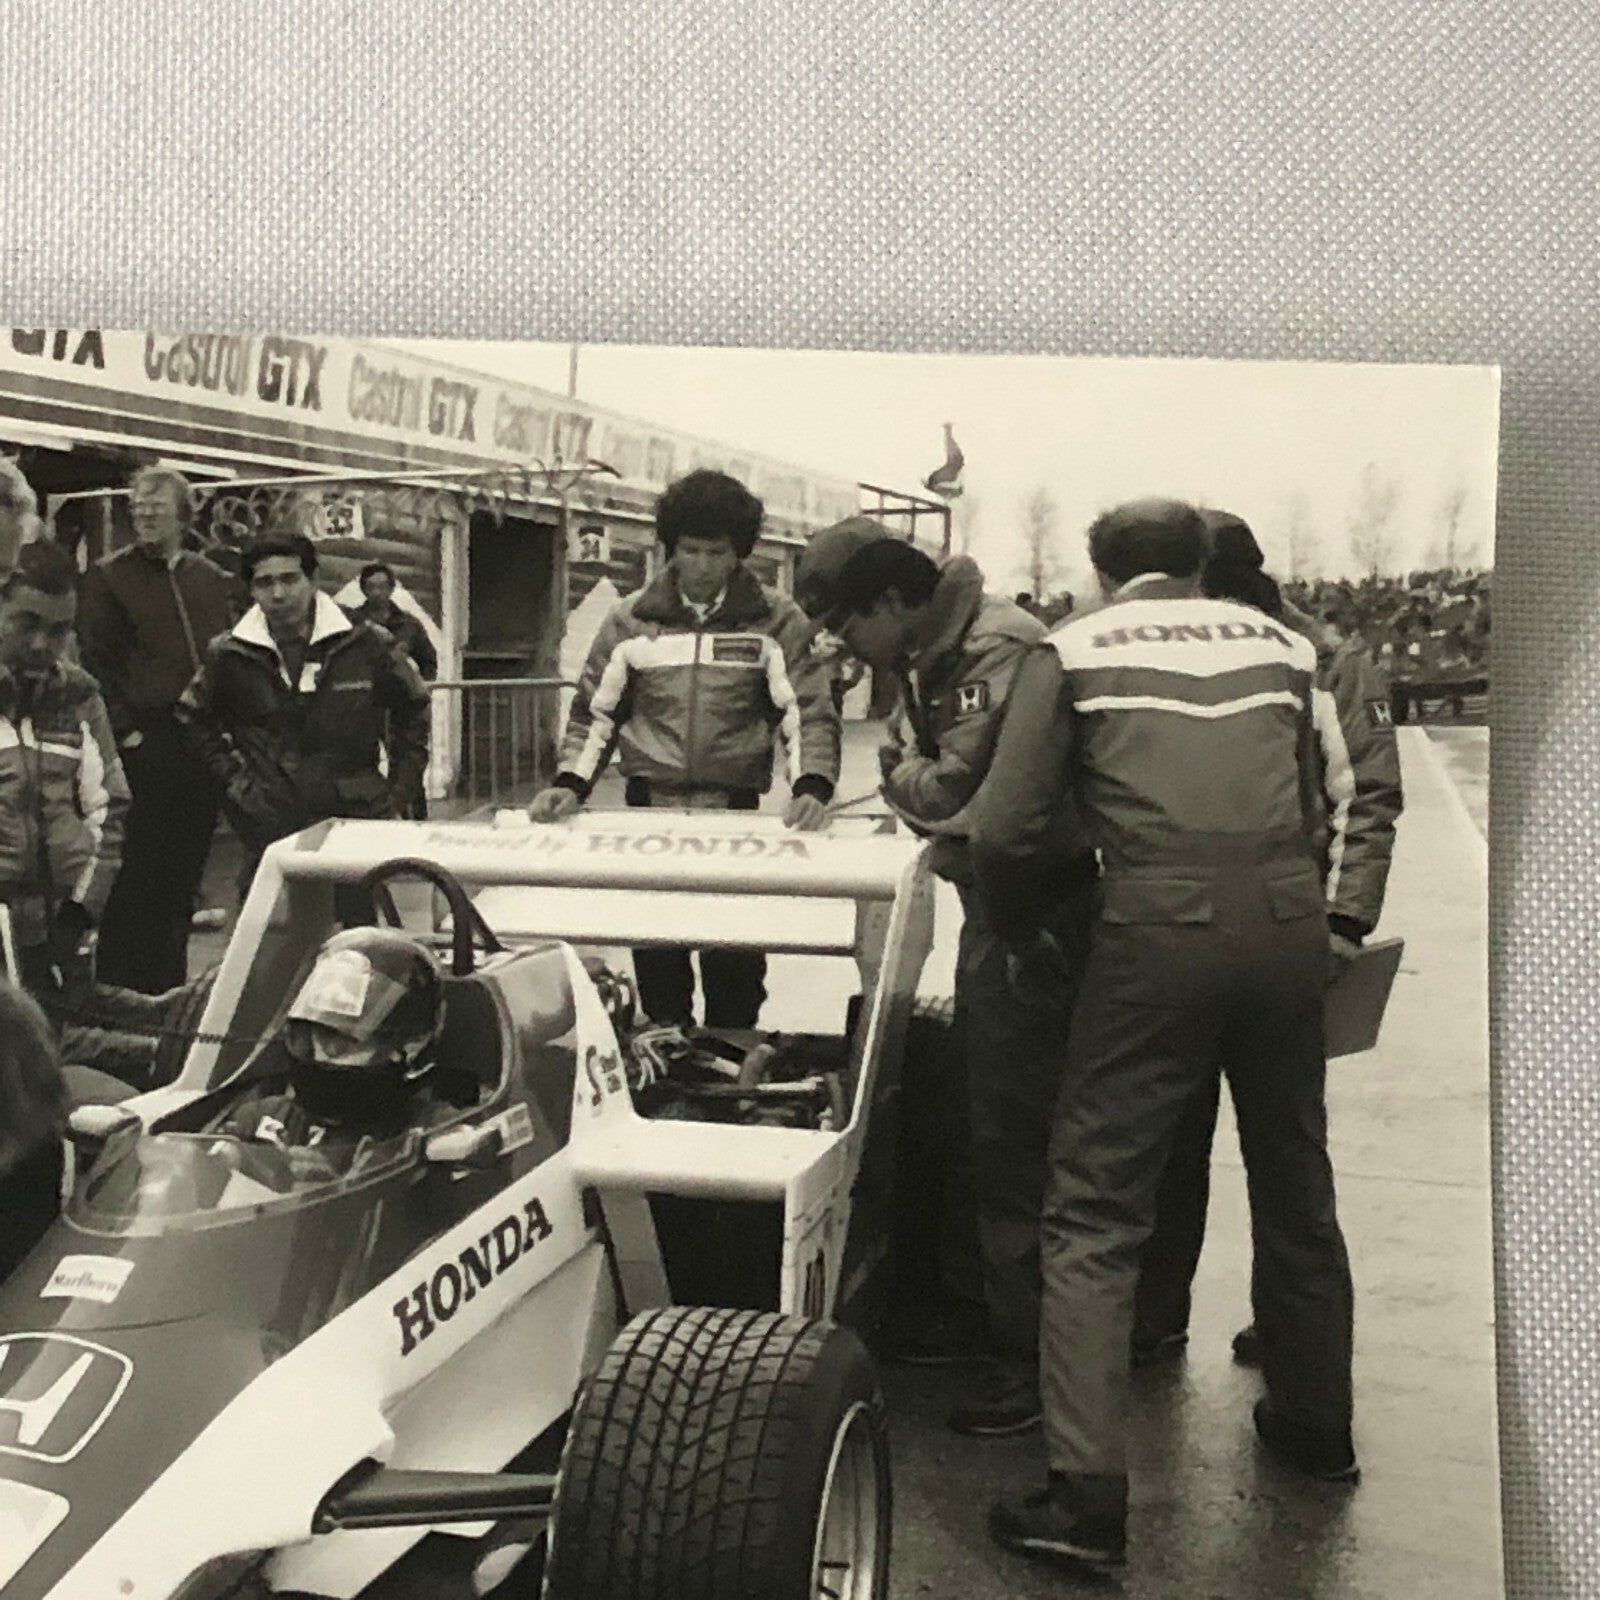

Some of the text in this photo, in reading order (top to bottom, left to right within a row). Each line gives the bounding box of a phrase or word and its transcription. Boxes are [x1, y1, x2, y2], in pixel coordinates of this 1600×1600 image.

[257, 335, 328, 412] GTX
[1092, 621, 1295, 649] HONDA
[586, 832, 812, 861] HONDA
[392, 1197, 554, 1358] HONDA
